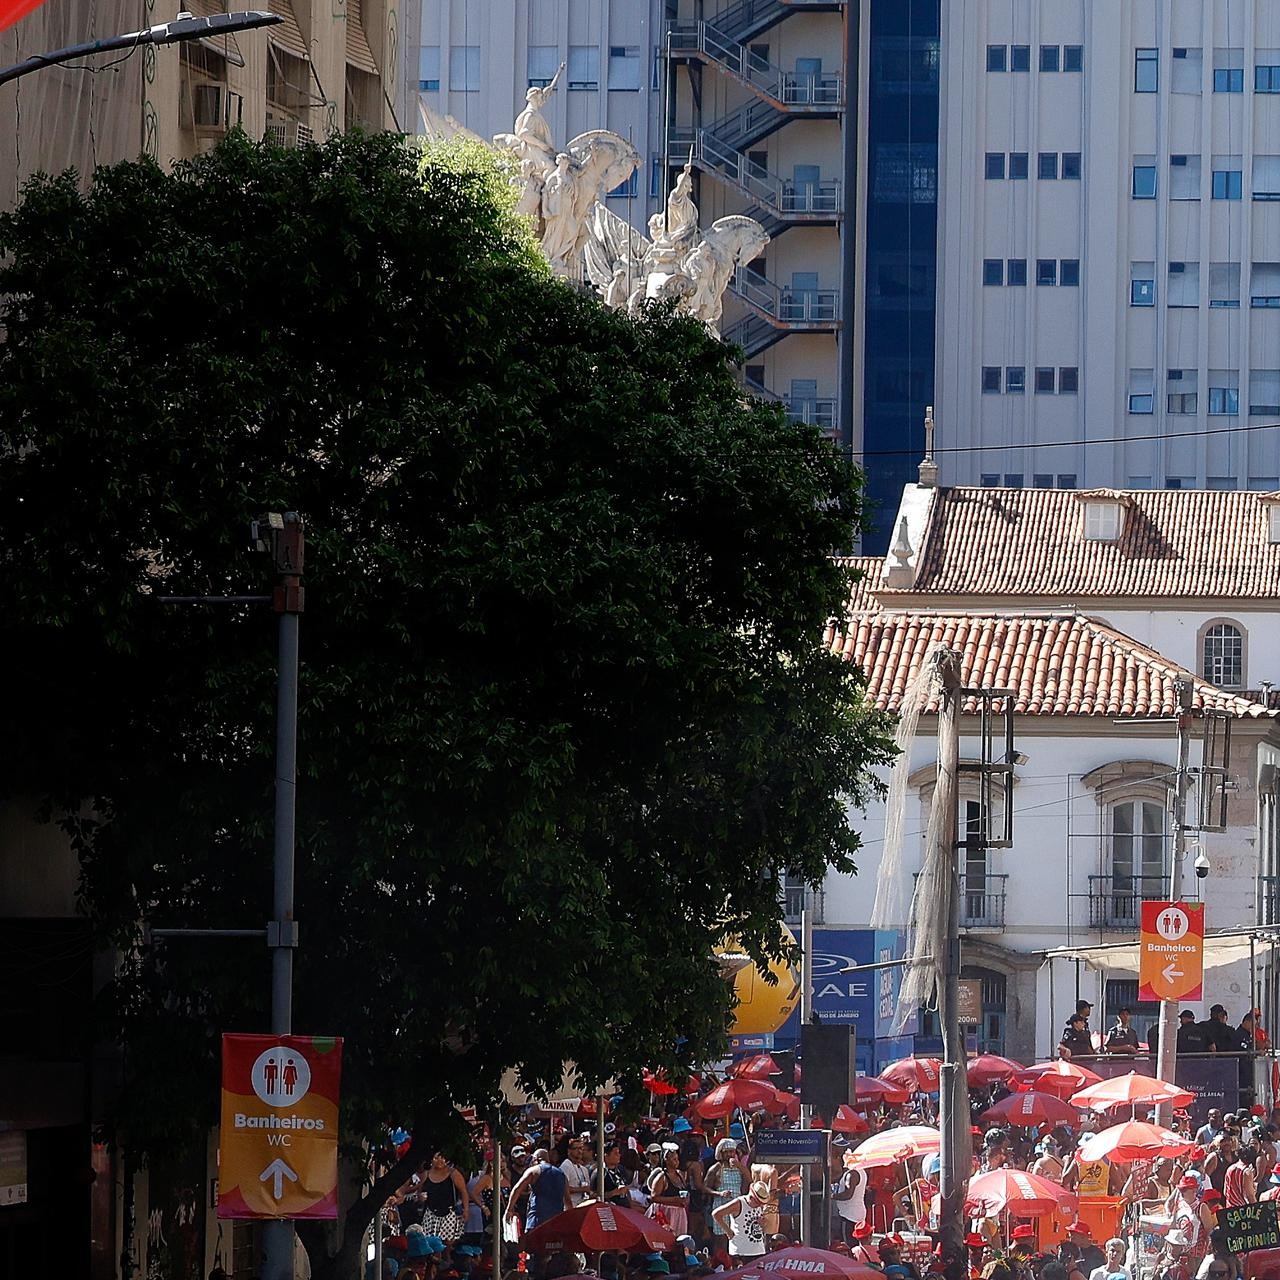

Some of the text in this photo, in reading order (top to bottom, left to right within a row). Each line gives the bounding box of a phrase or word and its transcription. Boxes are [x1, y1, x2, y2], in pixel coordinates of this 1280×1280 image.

[1147, 943, 1196, 953] Banheiros
[1164, 953, 1178, 961] WC
[234, 1113, 325, 1131] Banheiros
[267, 1134, 291, 1147] WC
[757, 1132, 774, 1140] Praça
[760, 1260, 826, 1274] BRAHMA
